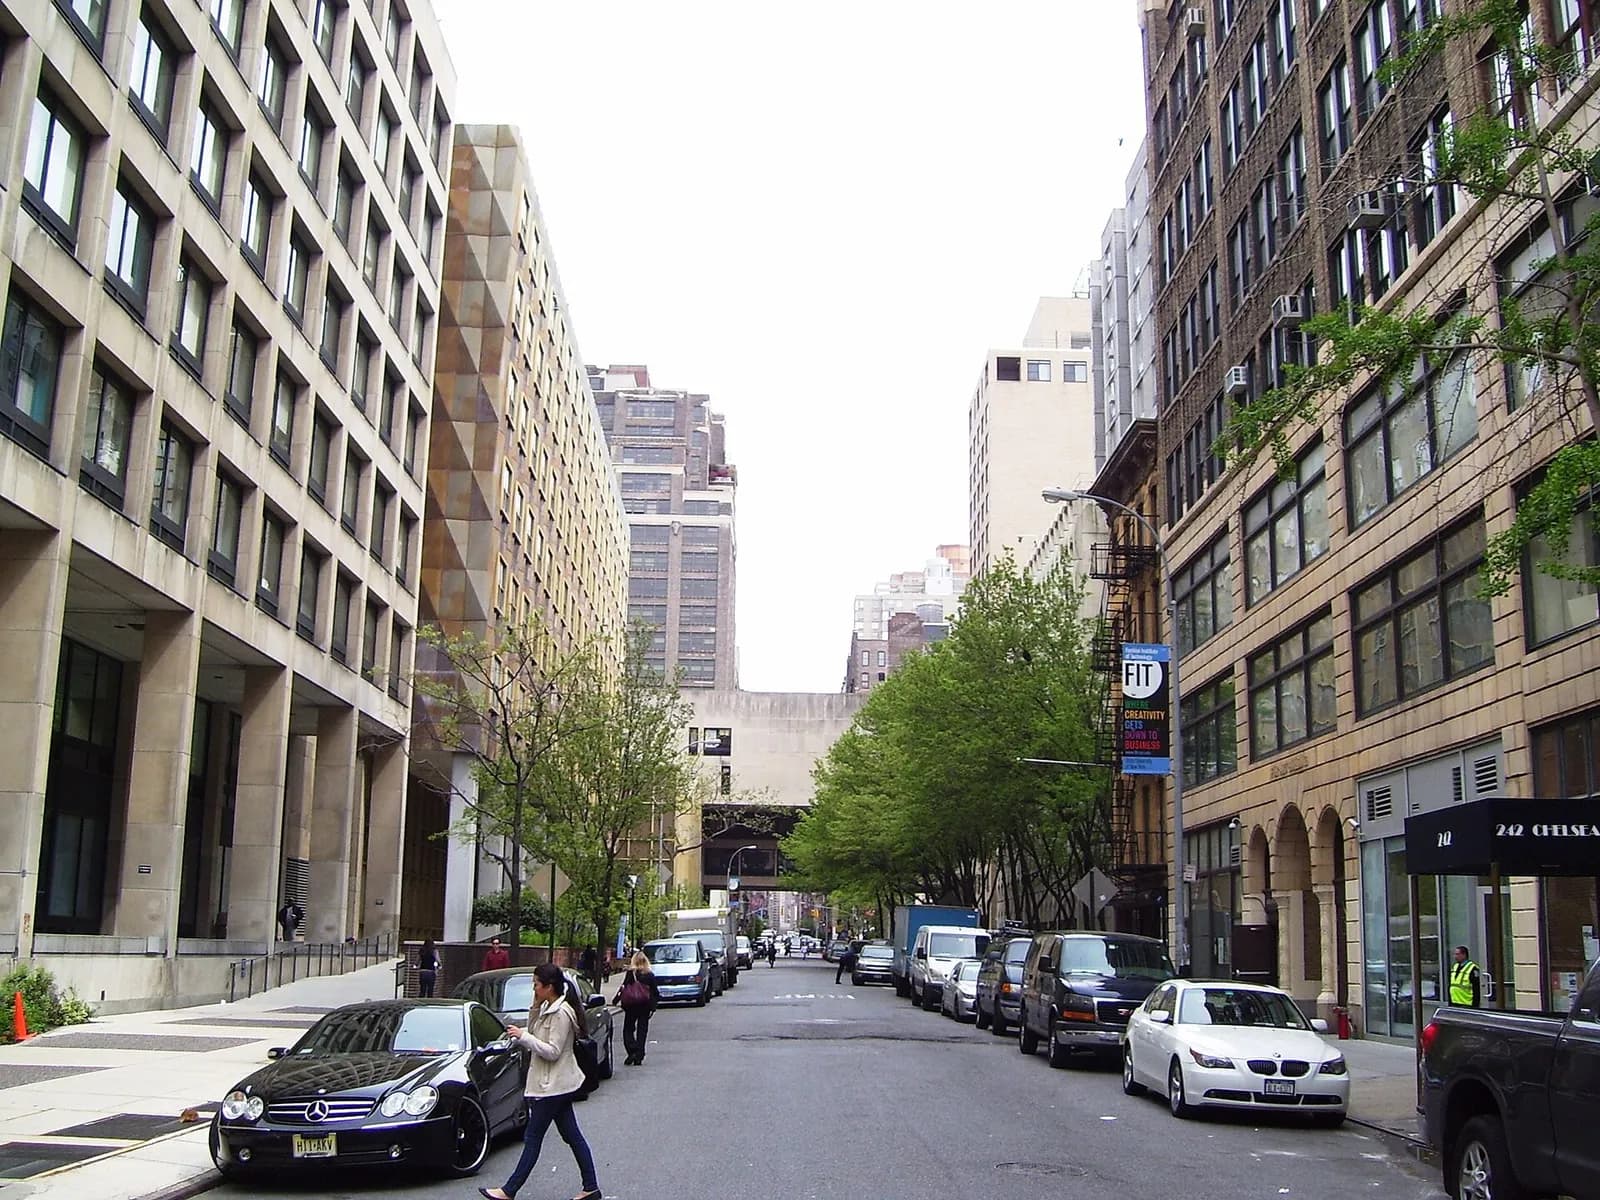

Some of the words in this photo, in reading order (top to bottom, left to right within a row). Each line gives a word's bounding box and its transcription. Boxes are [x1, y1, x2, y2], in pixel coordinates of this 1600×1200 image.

[1125, 663, 1153, 687] FIT
[1125, 710, 1165, 719] CREATIVITY
[1125, 721, 1143, 729] GETS
[1125, 730, 1147, 740] DOWN
[1148, 731, 1158, 740] TO
[1125, 740, 1161, 750] BUSINESS
[1496, 824, 1524, 836] 242
[1532, 824, 1600, 836] CHELSEA
